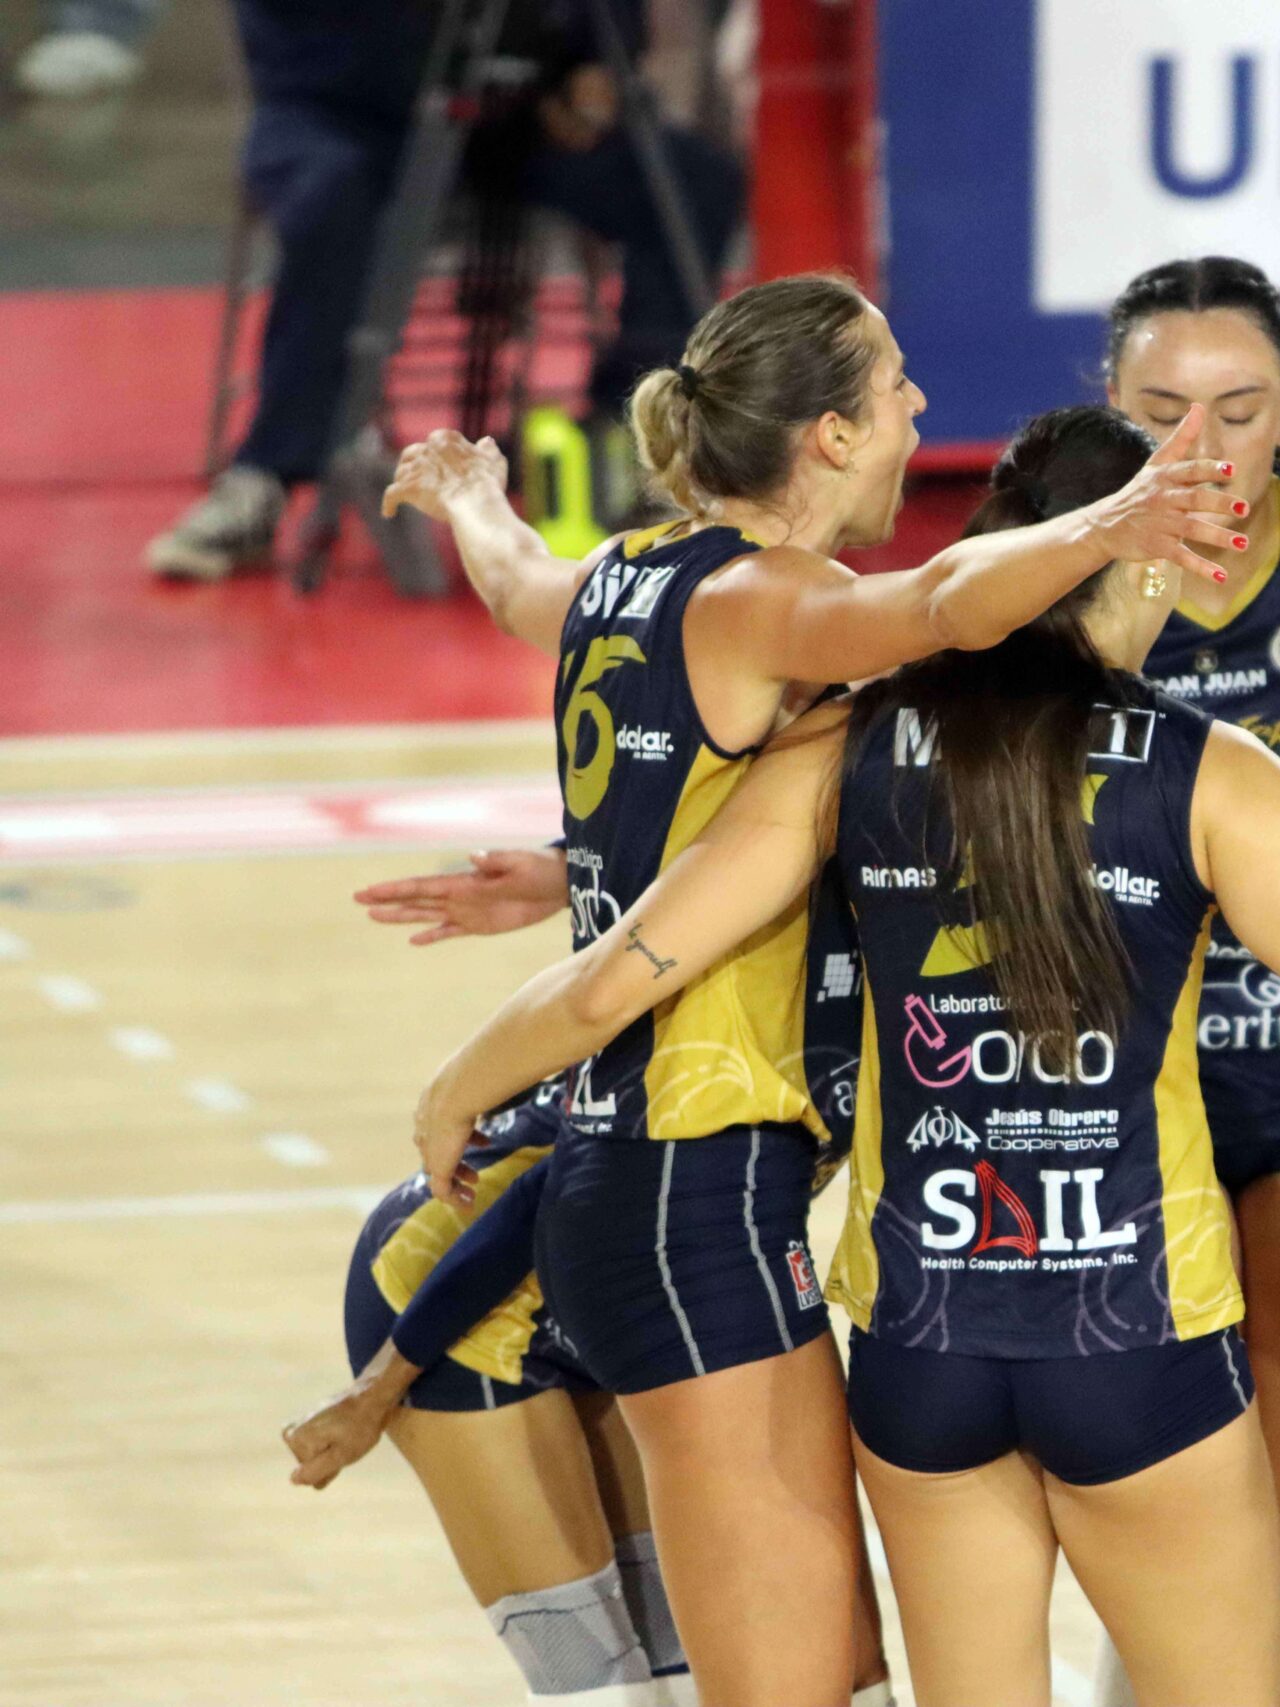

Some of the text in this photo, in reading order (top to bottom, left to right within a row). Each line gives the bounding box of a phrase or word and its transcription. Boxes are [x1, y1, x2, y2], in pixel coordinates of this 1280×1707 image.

[1203, 669, 1267, 692] JUAN
[987, 1135, 1120, 1152] Cooperativa
[921, 1256, 965, 1271] Health
[968, 1257, 1037, 1273] Computer
[1112, 1252, 1139, 1266] Inc.
